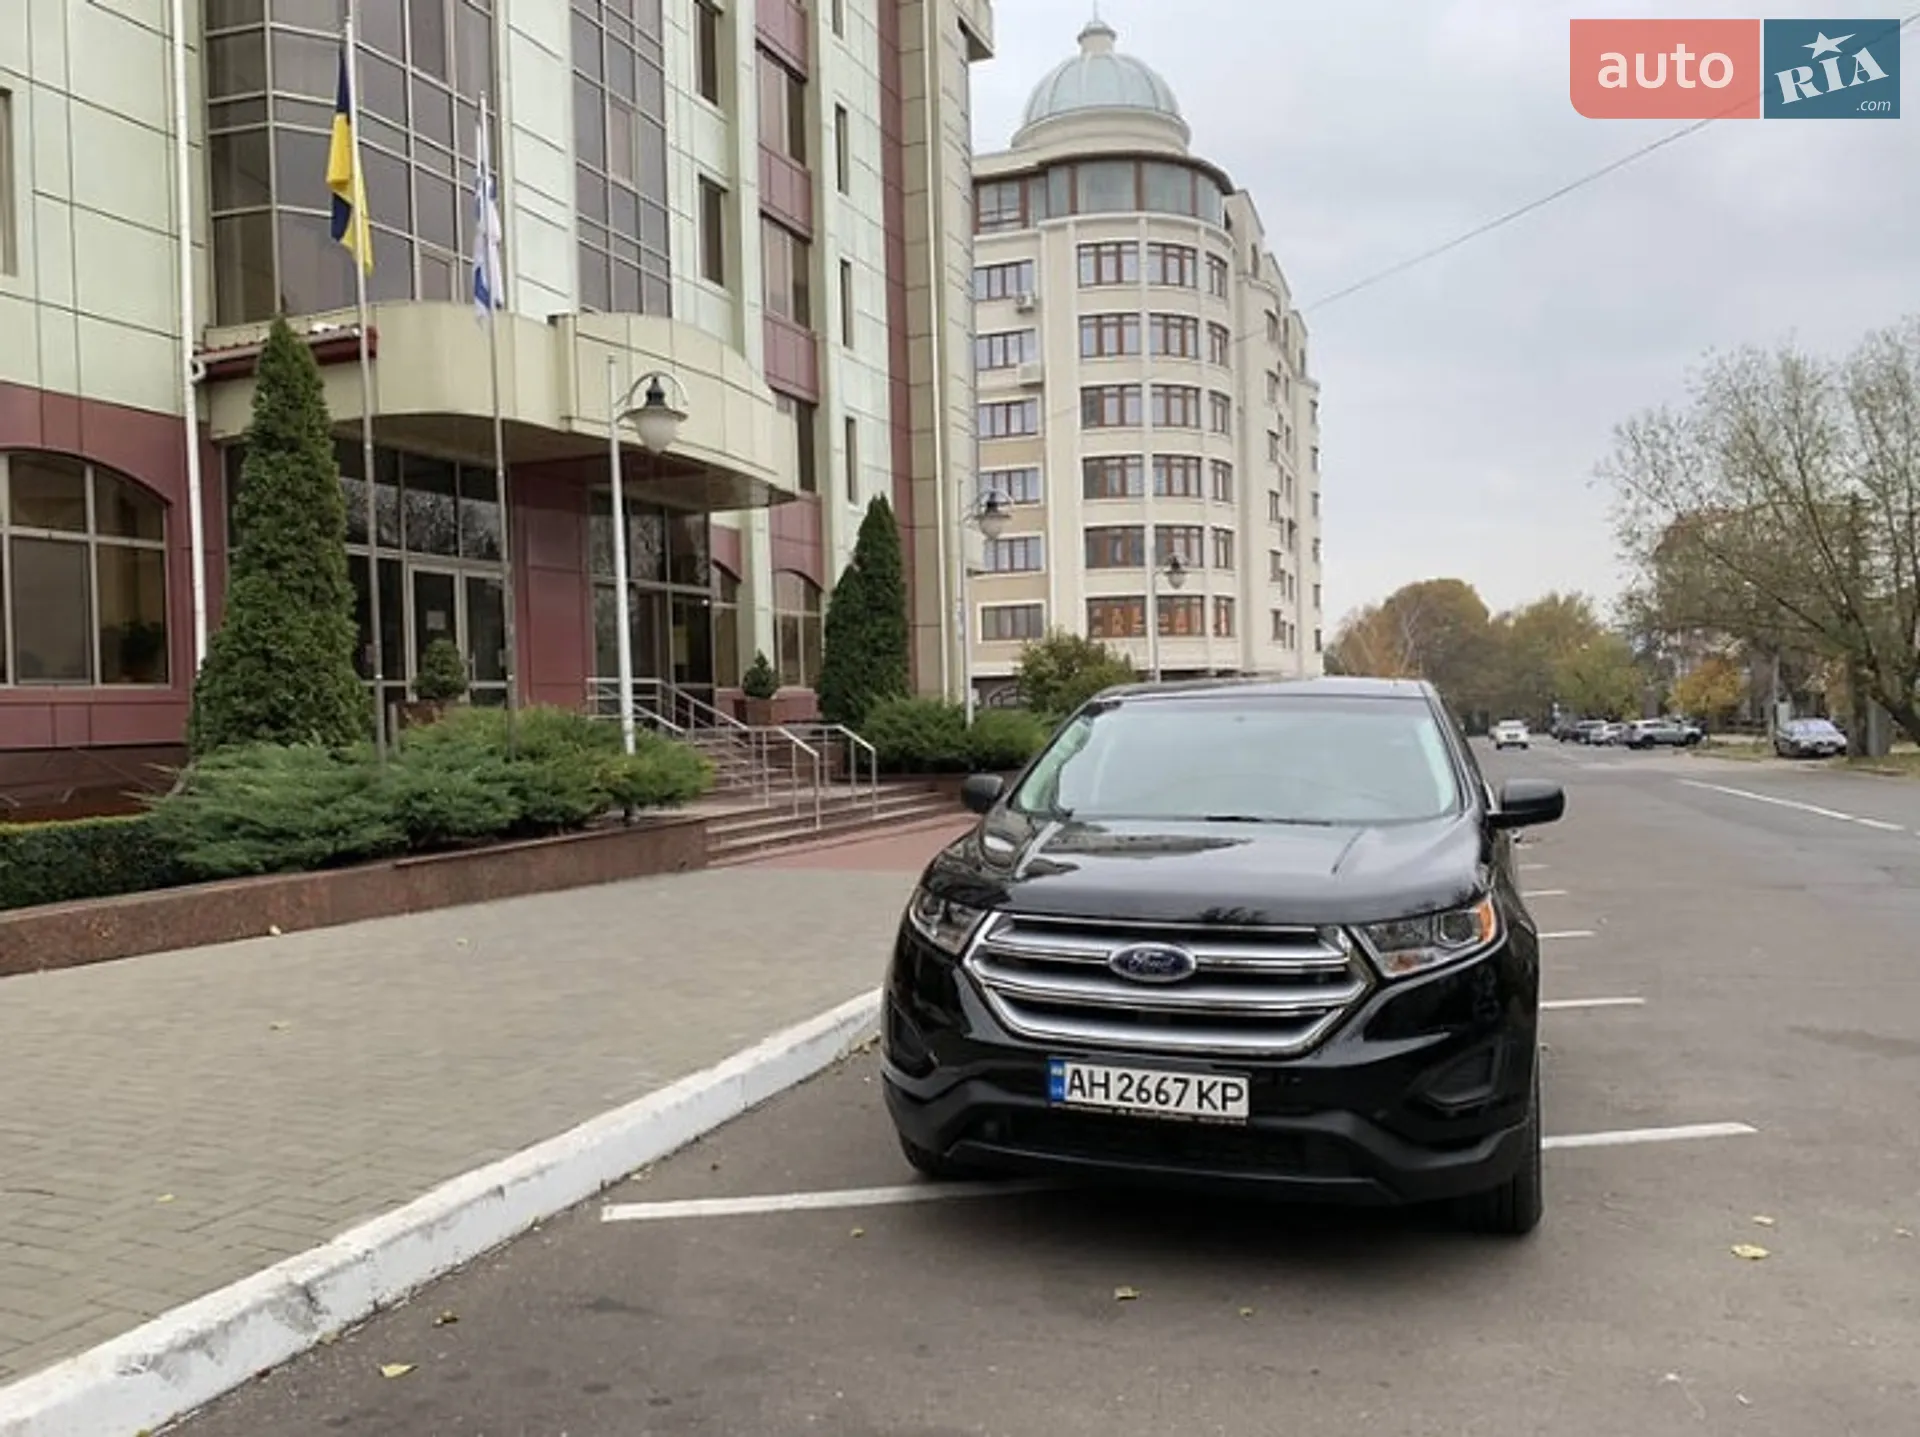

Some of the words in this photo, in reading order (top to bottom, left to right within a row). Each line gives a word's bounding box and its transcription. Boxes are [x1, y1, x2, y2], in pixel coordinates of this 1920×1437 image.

[1067, 1068, 1111, 1101] AH
[1116, 1072, 1191, 1107] 2667
[1197, 1079, 1244, 1112] KP
